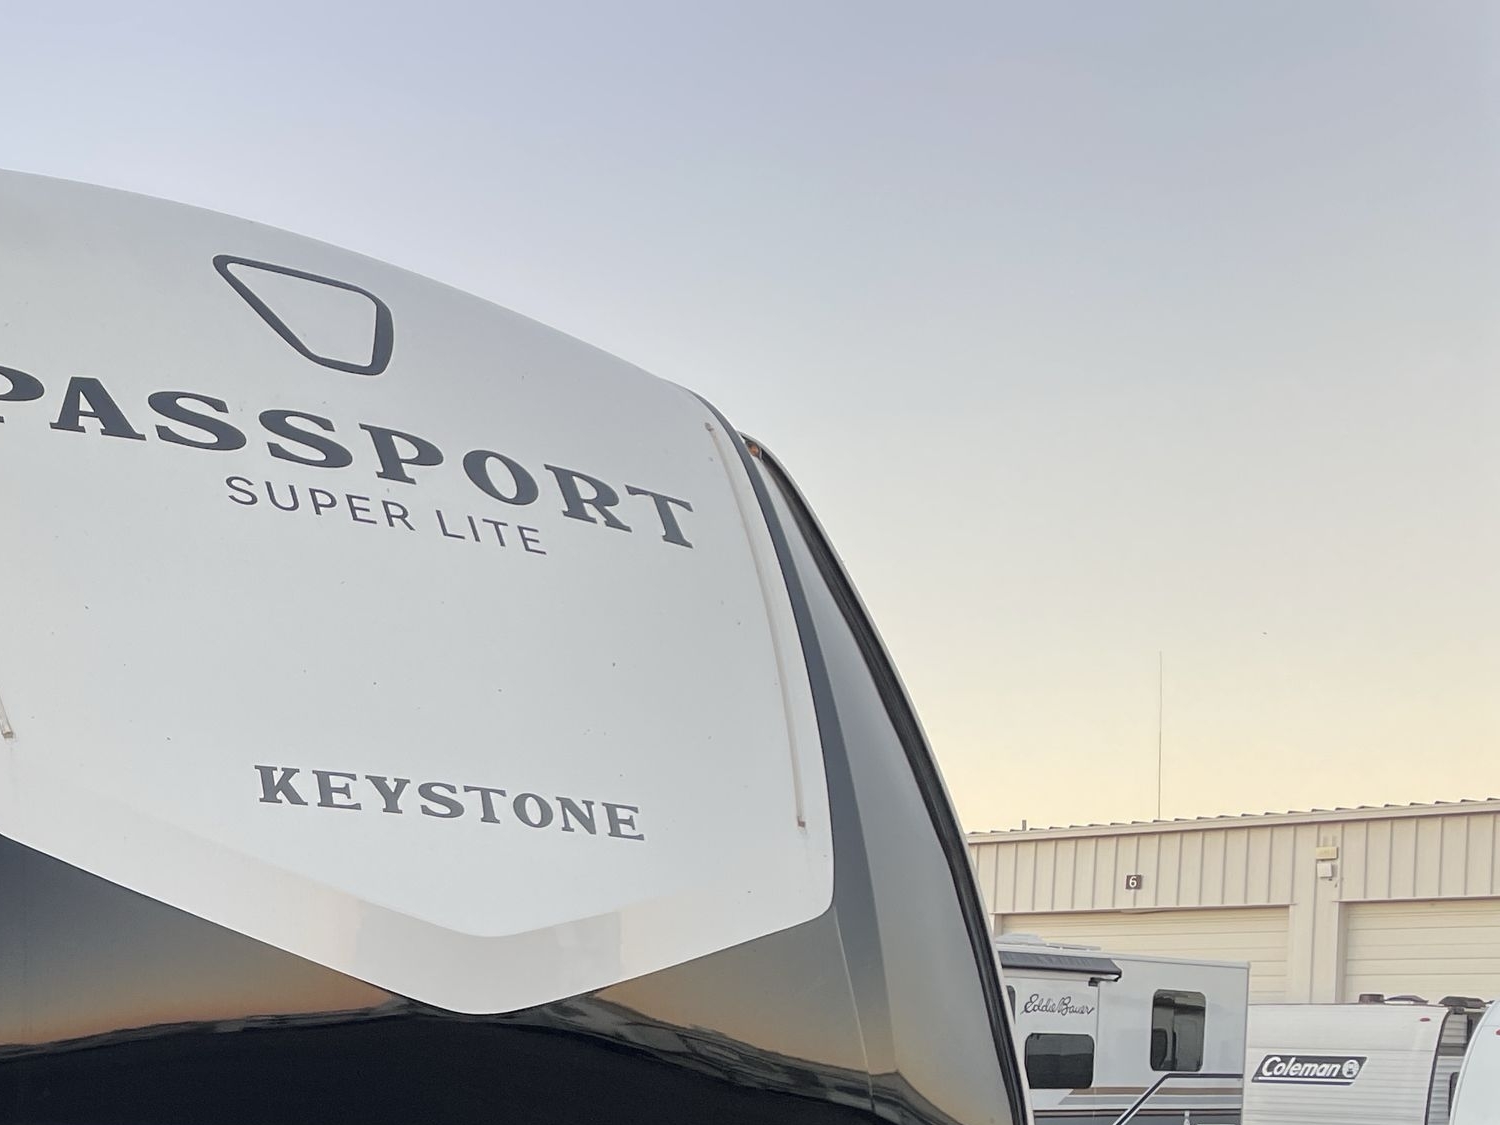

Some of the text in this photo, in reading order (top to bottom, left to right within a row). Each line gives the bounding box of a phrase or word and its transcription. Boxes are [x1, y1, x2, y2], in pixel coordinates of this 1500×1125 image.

[224, 475, 548, 556] SUPER LITE
[253, 763, 646, 842] KEYSTONE
[1129, 875, 1138, 888] 6
[1020, 993, 1095, 1016] Eddie Bauer
[1261, 1056, 1342, 1077] Coleman
